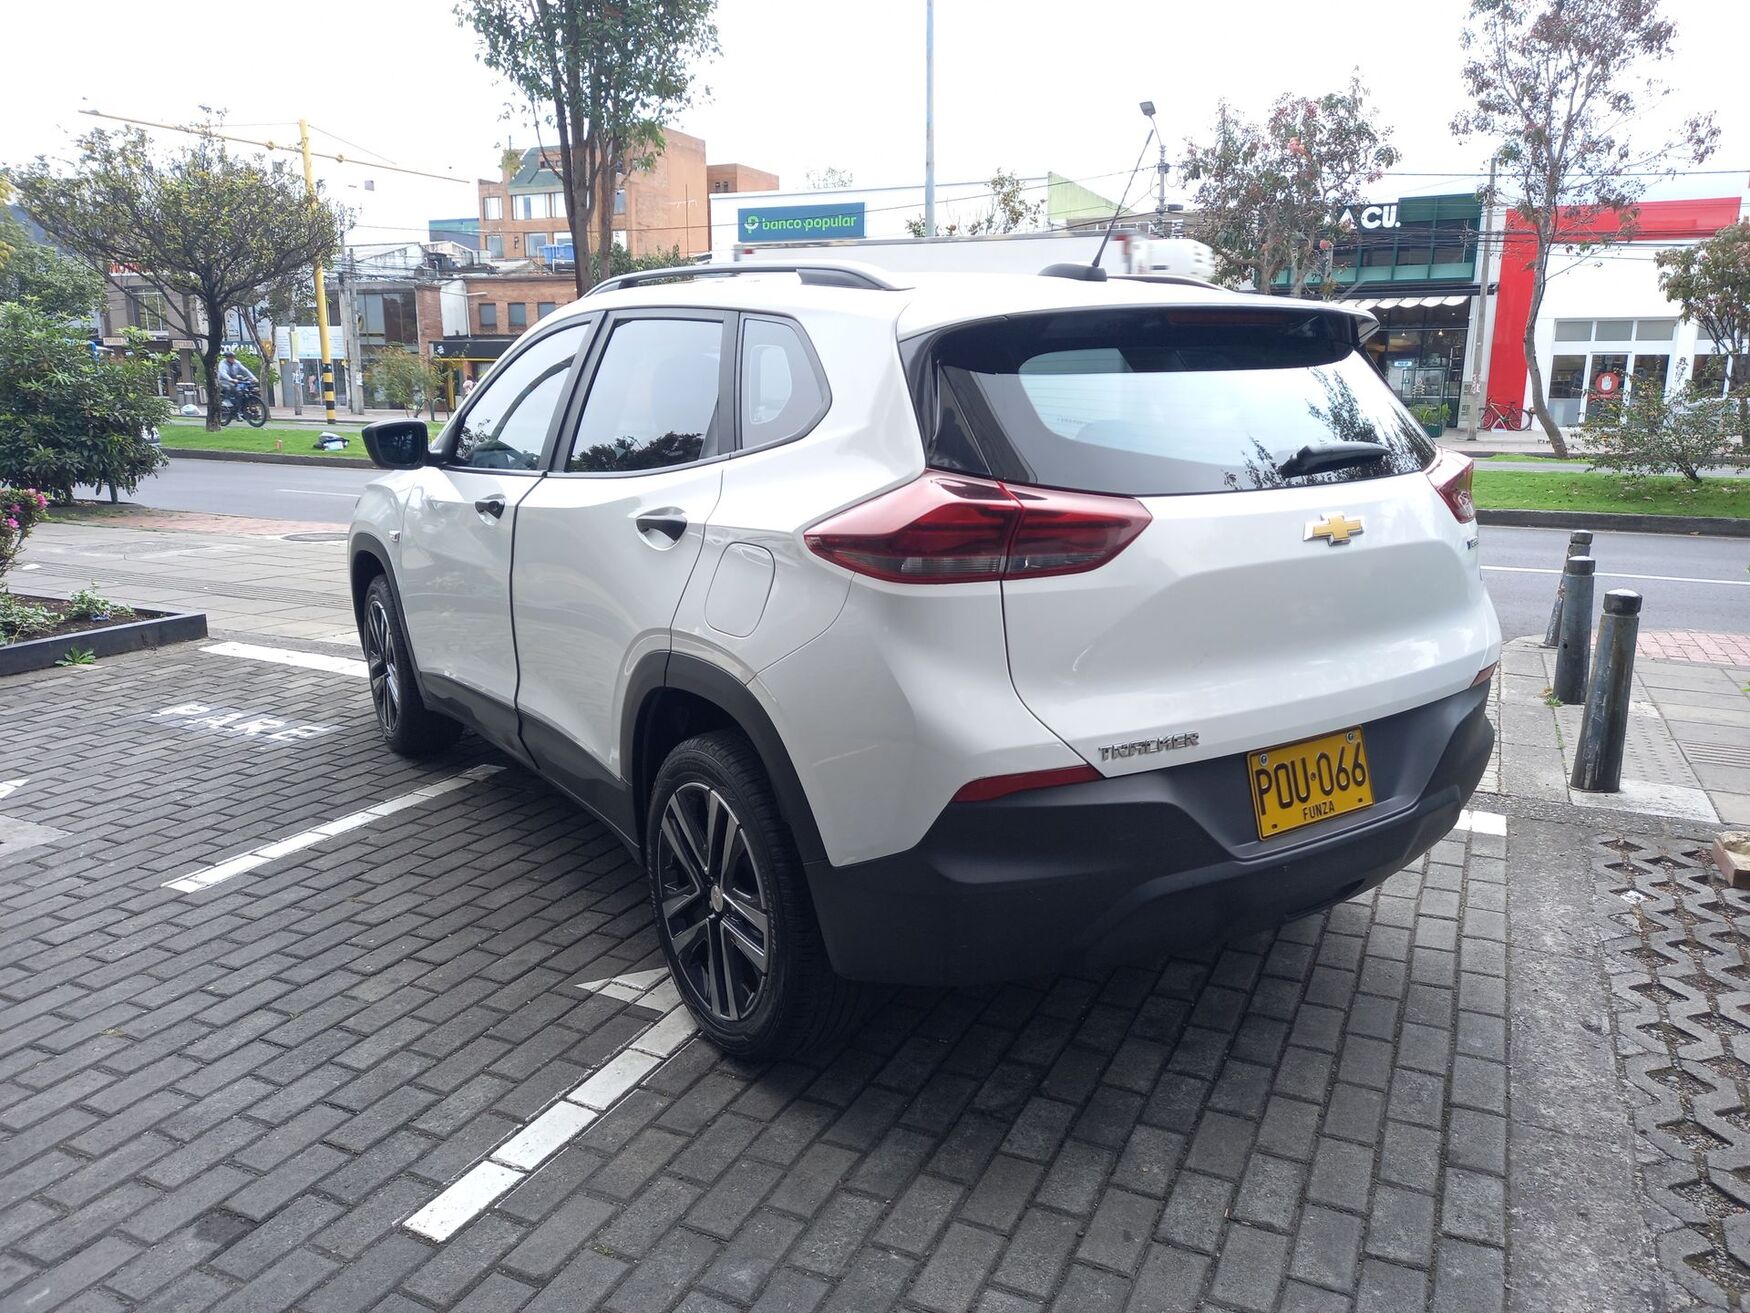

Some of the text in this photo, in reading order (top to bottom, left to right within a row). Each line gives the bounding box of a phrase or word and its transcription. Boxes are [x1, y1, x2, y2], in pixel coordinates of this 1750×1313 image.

[762, 215, 857, 231] banco popular
[151, 702, 330, 741] PARE
[1098, 731, 1200, 761] TRACKER
[1302, 800, 1336, 821] FUNZA
